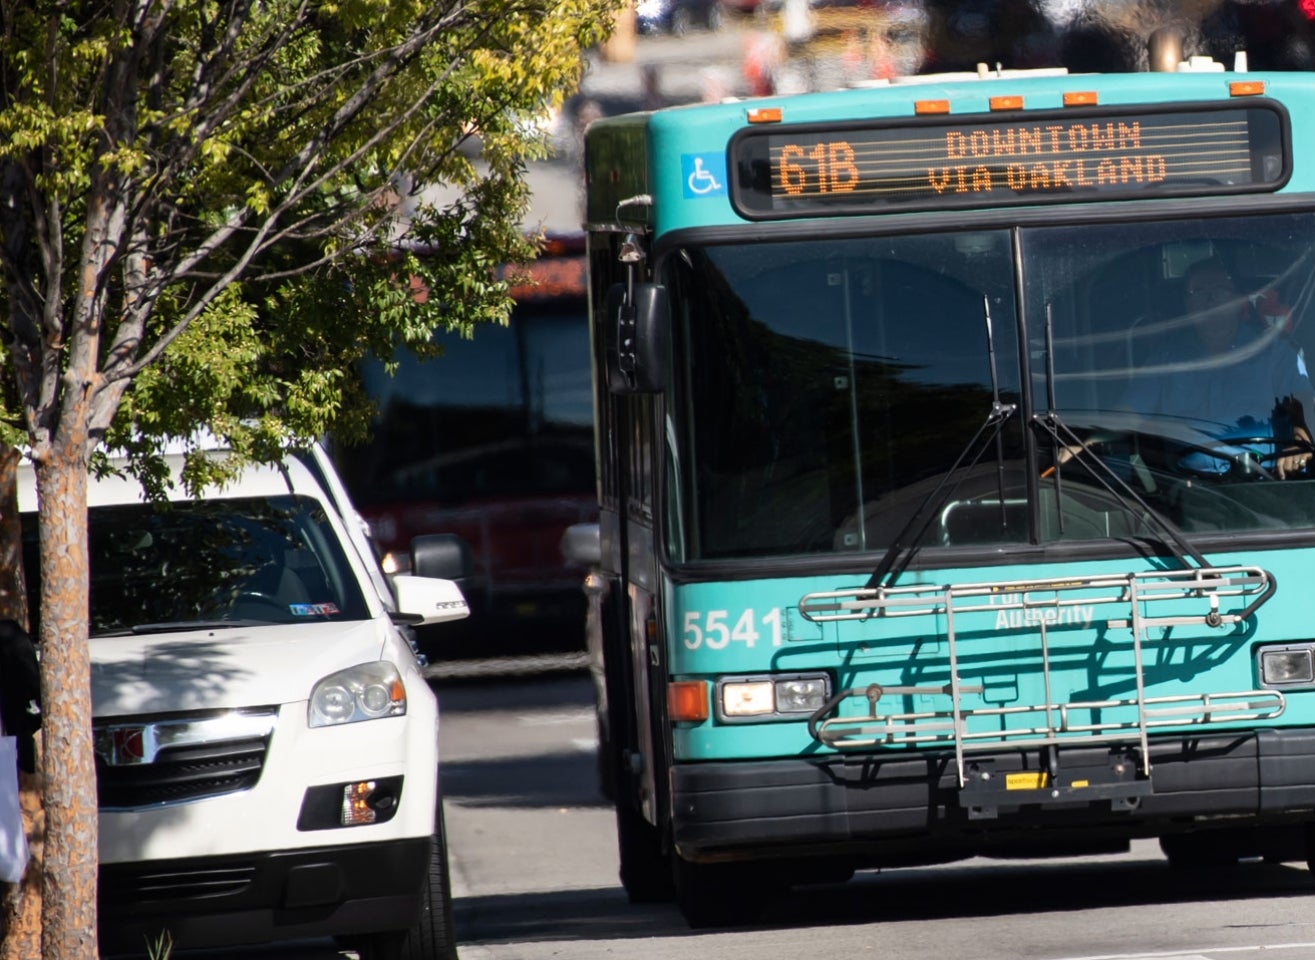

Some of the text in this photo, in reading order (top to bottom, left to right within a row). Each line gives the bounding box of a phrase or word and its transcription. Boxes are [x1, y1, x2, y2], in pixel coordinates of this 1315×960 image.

[946, 121, 1141, 159] DOWNTOWN
[779, 141, 859, 195] 61B
[928, 154, 1166, 194] VIA OAKLAND
[683, 607, 782, 650] 5541
[994, 605, 1094, 631] Authority
